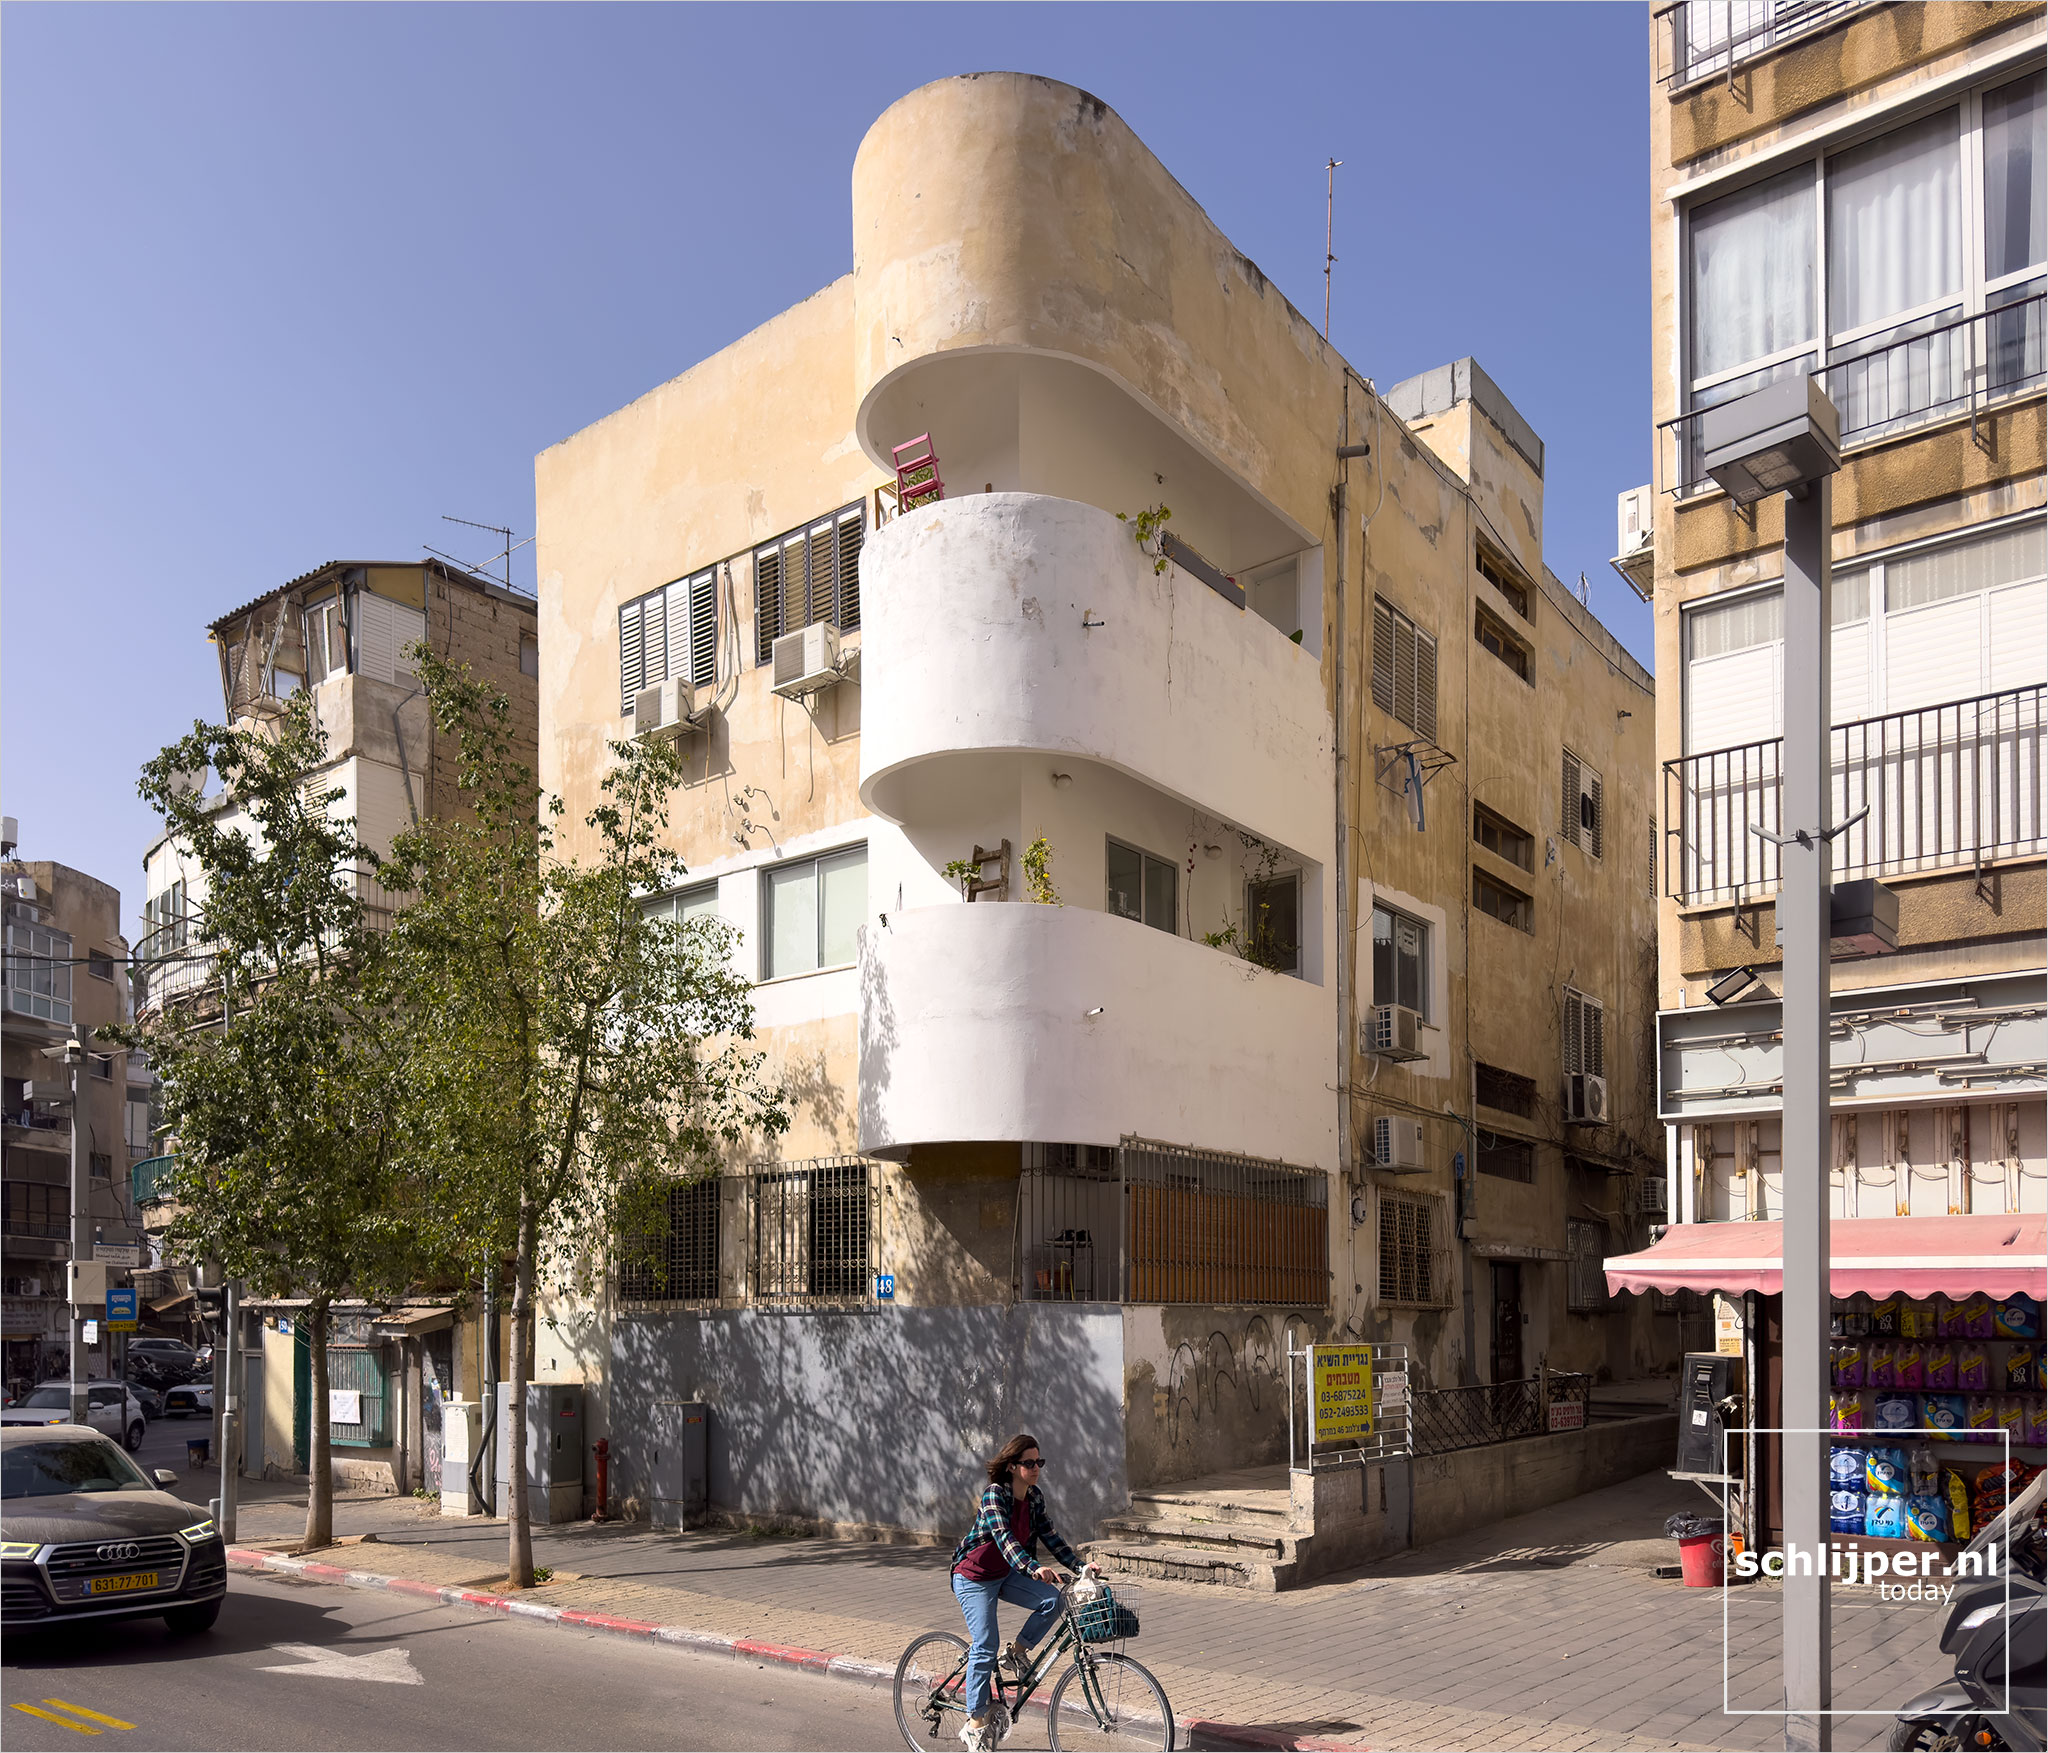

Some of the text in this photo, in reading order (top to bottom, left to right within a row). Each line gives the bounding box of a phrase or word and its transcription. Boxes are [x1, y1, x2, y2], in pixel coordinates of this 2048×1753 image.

[879, 1279, 892, 1293] 48
[1317, 1353, 1369, 1368] נגריית השיא
[1326, 1372, 1360, 1387] מטבחים
[1321, 1389, 1366, 1403] 03-6875224
[1319, 1405, 1369, 1419] 052-2493533
